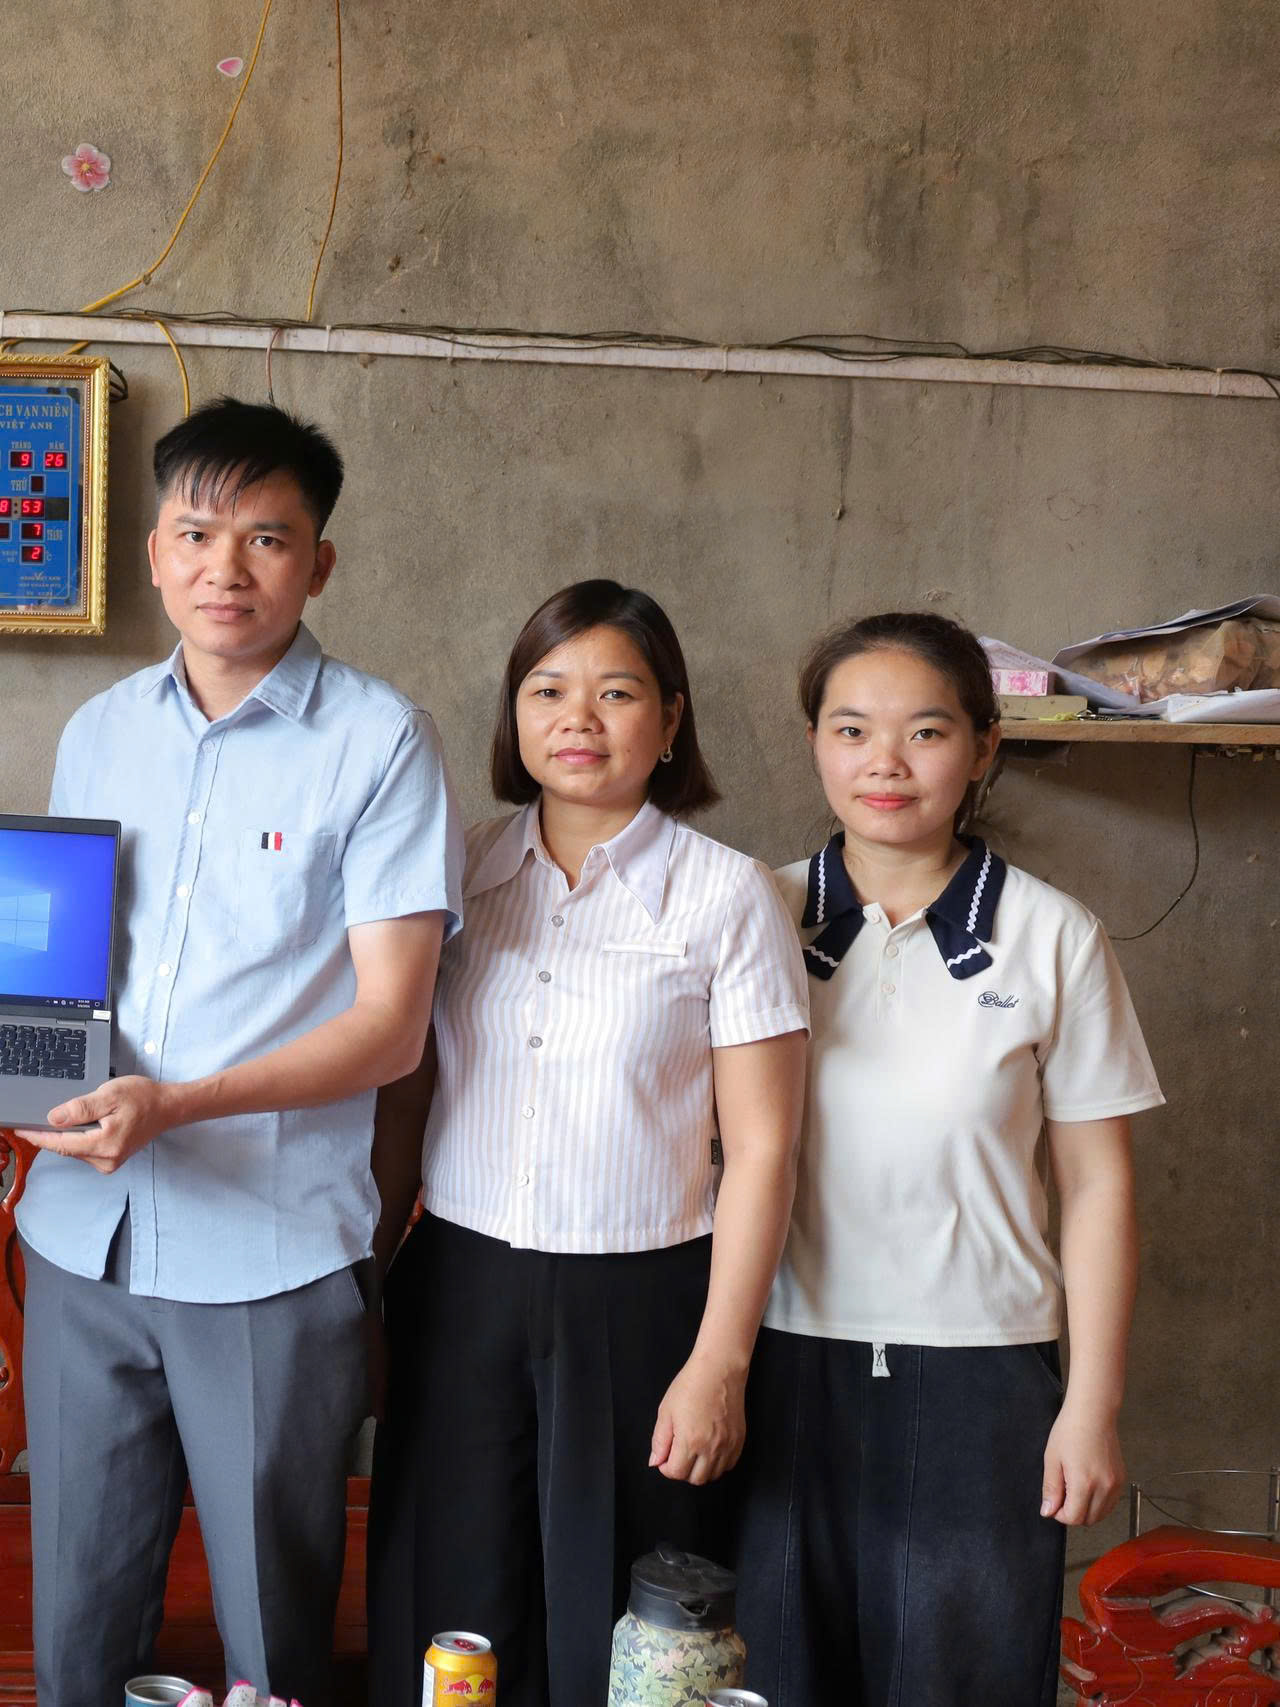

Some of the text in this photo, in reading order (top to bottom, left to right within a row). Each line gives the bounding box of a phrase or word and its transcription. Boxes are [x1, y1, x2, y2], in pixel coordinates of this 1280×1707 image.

[42, 402, 69, 417] NIÊN
[30, 422, 53, 430] ANH
[21, 454, 30, 466] 9
[45, 454, 64, 467] 26
[22, 501, 42, 513] 53
[33, 524, 41, 536] 7
[31, 547, 41, 560] 2
